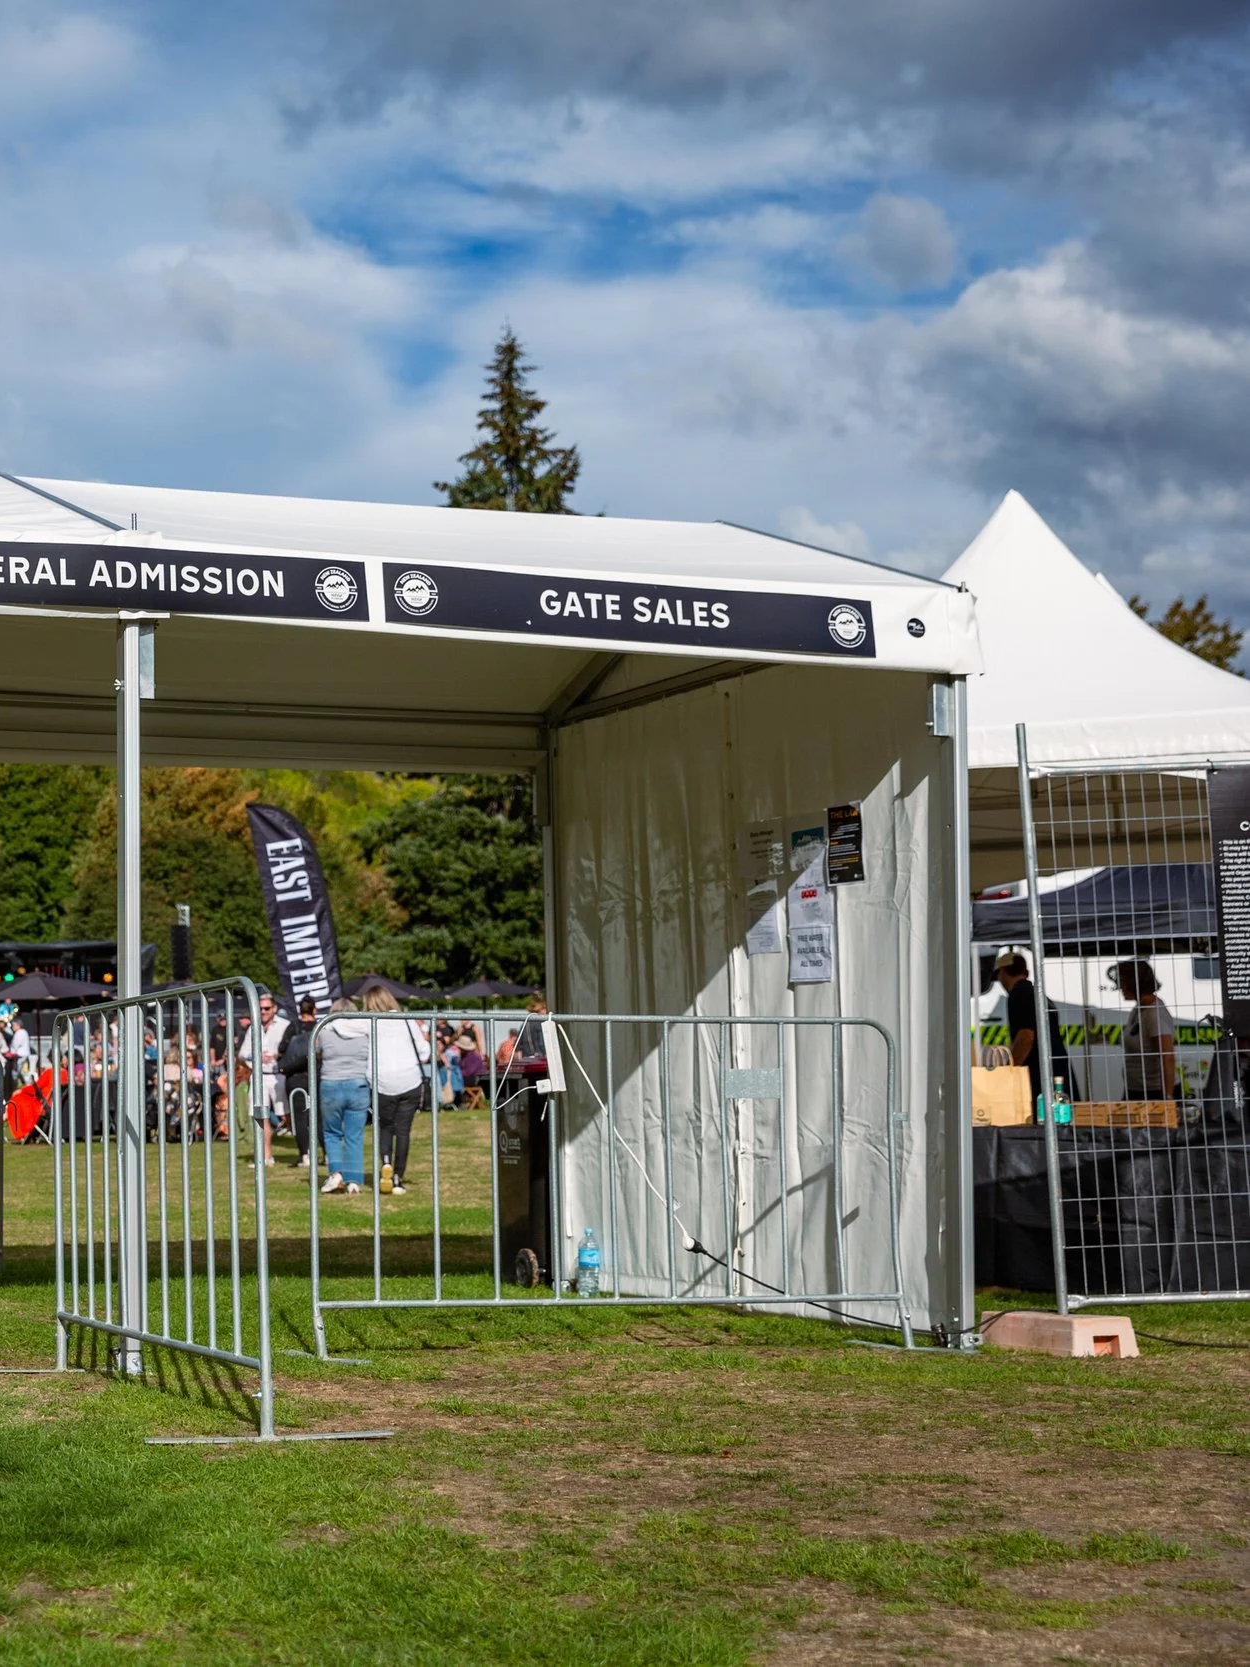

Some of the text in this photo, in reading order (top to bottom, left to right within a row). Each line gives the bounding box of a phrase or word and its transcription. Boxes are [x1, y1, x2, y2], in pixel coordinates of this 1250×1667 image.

[89, 559, 285, 597] ADMISSION
[539, 589, 731, 629] GATE SALES
[265, 838, 312, 902] EAST
